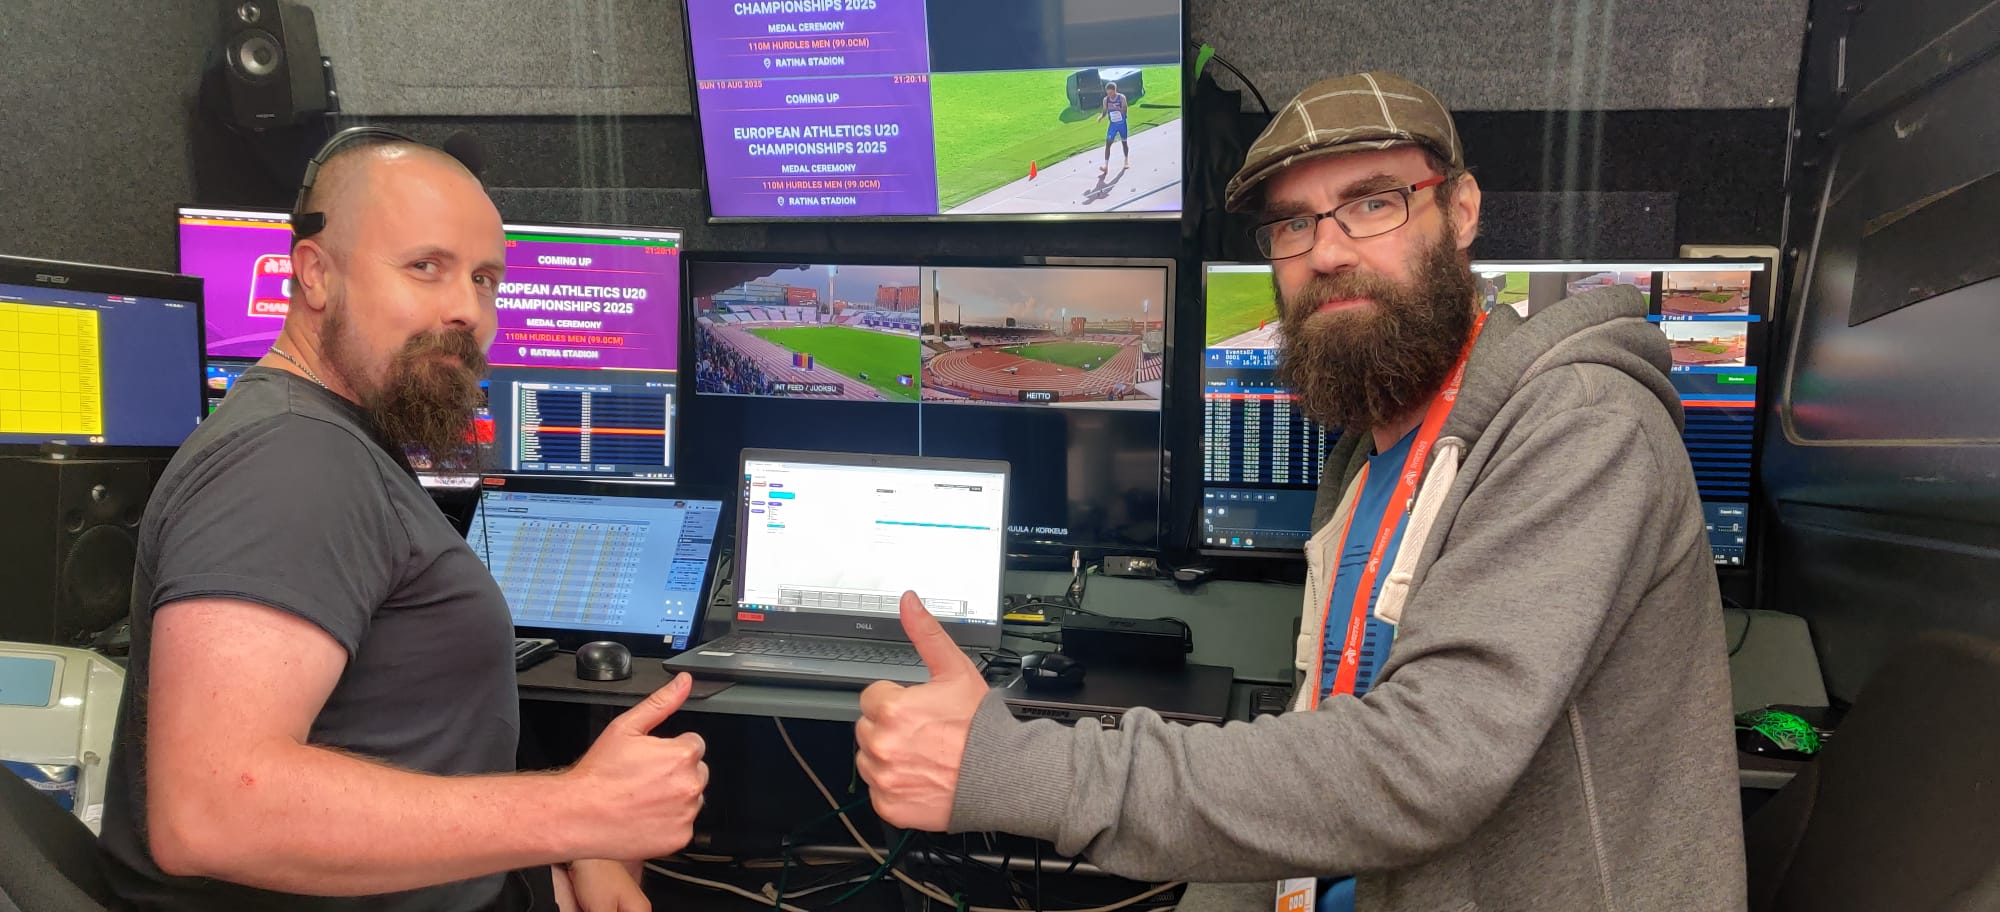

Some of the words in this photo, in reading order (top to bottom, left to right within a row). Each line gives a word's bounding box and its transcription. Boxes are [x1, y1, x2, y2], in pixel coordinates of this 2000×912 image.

[734, 0, 842, 15] CHAMPIONSHIPS
[845, 0, 876, 10] 2025
[768, 24, 797, 33] MEDAL
[798, 21, 844, 32] CEREMONY
[749, 42, 770, 51] 110M
[773, 41, 809, 50] HURDLES
[812, 39, 830, 49] MEN
[832, 37, 870, 49] (99.0CM)
[775, 58, 807, 67] RATINA
[808, 56, 844, 66] STADION
[699, 81, 715, 89] SUN
[717, 81, 726, 89] 10
[727, 80, 743, 89] AUG
[744, 80, 763, 88] 2025
[786, 94, 824, 104] COMING
[826, 93, 839, 103] UP
[734, 126, 800, 140] EUROPEAN
[803, 124, 872, 138] ATHLETICS
[874, 123, 899, 137] U20
[749, 142, 854, 156] CHAMPIONSHIPS
[856, 141, 887, 154] 2025
[782, 164, 810, 174] MEDAL
[811, 163, 856, 173] CEREMONY
[762, 181, 784, 190] 110M
[786, 180, 822, 189] HURDLES
[824, 180, 842, 189] MEN
[844, 180, 880, 190] (99.0CM)
[789, 197, 819, 206] RATINA
[820, 196, 856, 205] STADION
[538, 255, 577, 266] COMING
[578, 256, 592, 267] UP
[498, 282, 550, 295] ROPEAN
[552, 284, 620, 298] ATHLETICS
[623, 287, 647, 300] U20
[495, 298, 601, 312] CHAMPIONSHIPS
[603, 302, 634, 314] 2025
[526, 318, 555, 327] MEDAL
[556, 320, 602, 329] CEREMONY
[505, 333, 528, 341] 110M
[529, 333, 565, 342] HURDLES
[568, 335, 586, 343] MEN
[588, 335, 624, 346] (99.0CM)
[530, 348, 560, 357] RATINA
[562, 349, 598, 359] STADION
[787, 383, 804, 391] FEED
[809, 384, 837, 392] JUOKSU
[1026, 391, 1051, 400] HEITTO
[1035, 527, 1068, 535] KORKEUS
[856, 622, 872, 630] DELL
